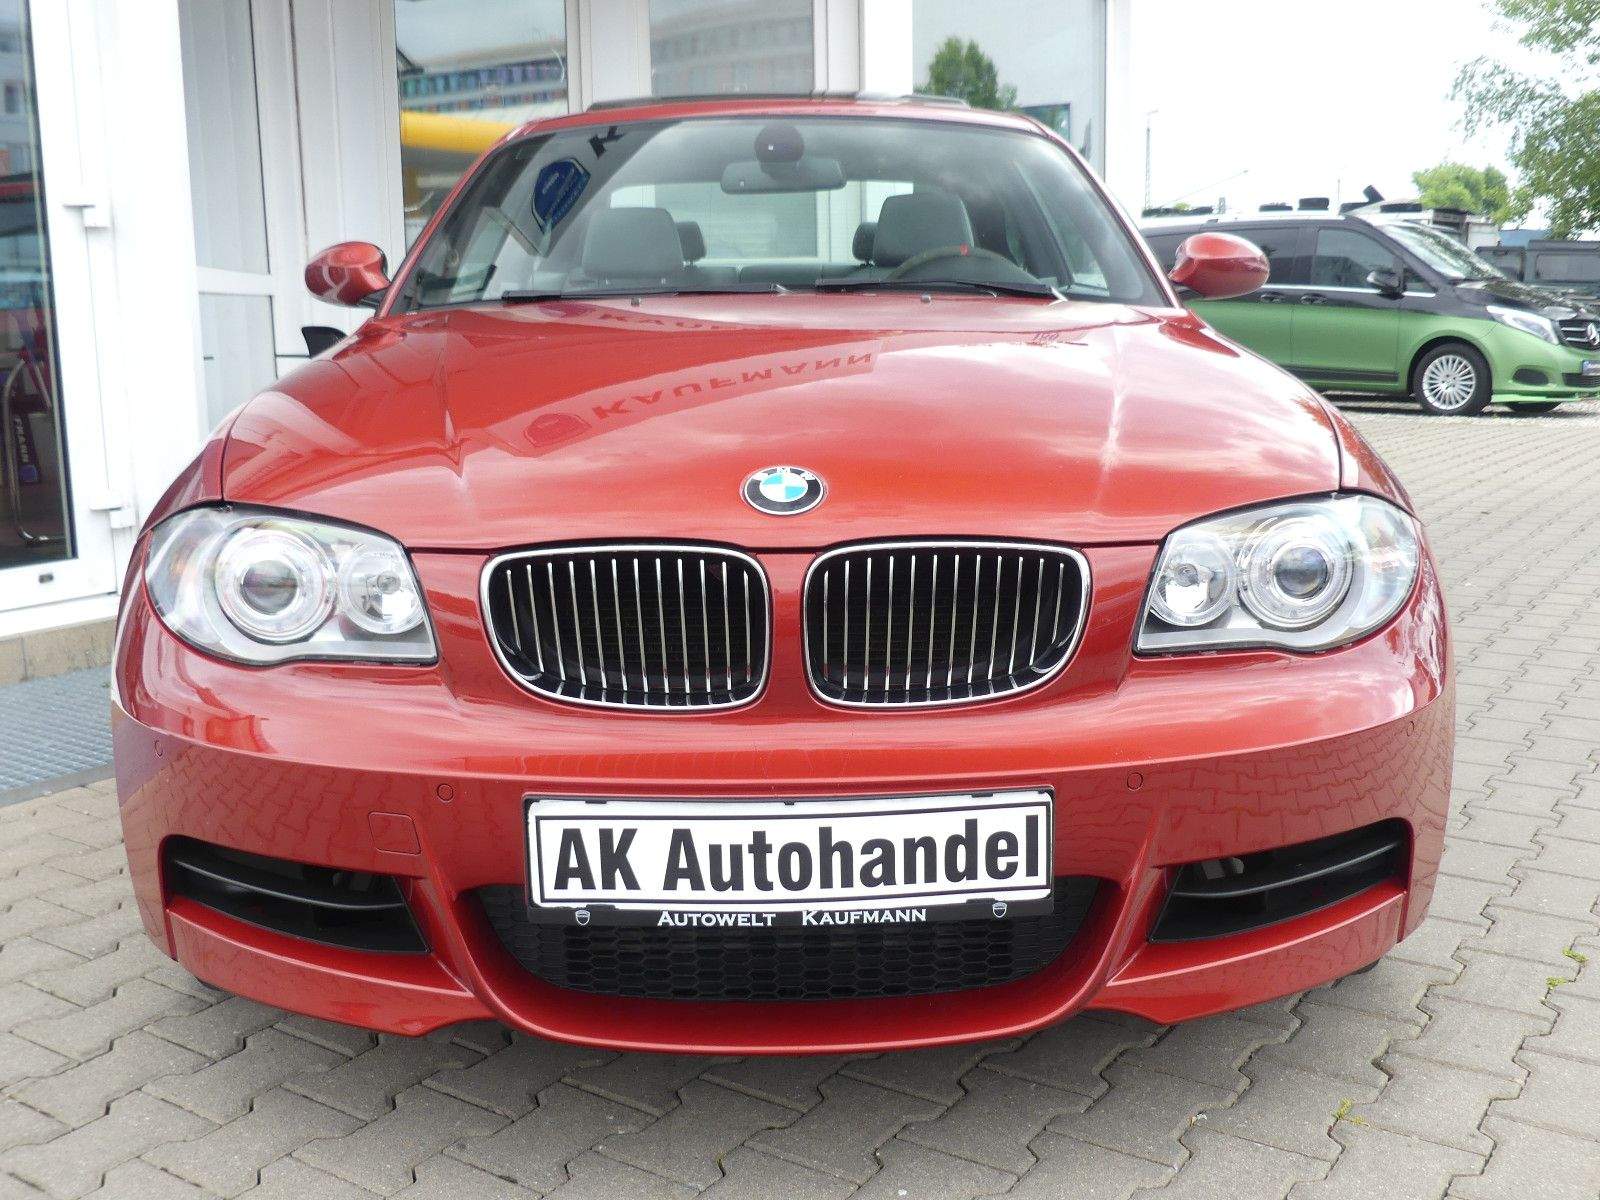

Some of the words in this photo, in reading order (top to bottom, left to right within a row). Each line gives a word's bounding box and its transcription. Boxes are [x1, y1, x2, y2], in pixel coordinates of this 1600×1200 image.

[553, 827, 641, 890] AK
[662, 814, 1039, 892] Autohandel
[657, 910, 777, 928] AUTOWELT
[802, 908, 927, 926] KAUFMANN
